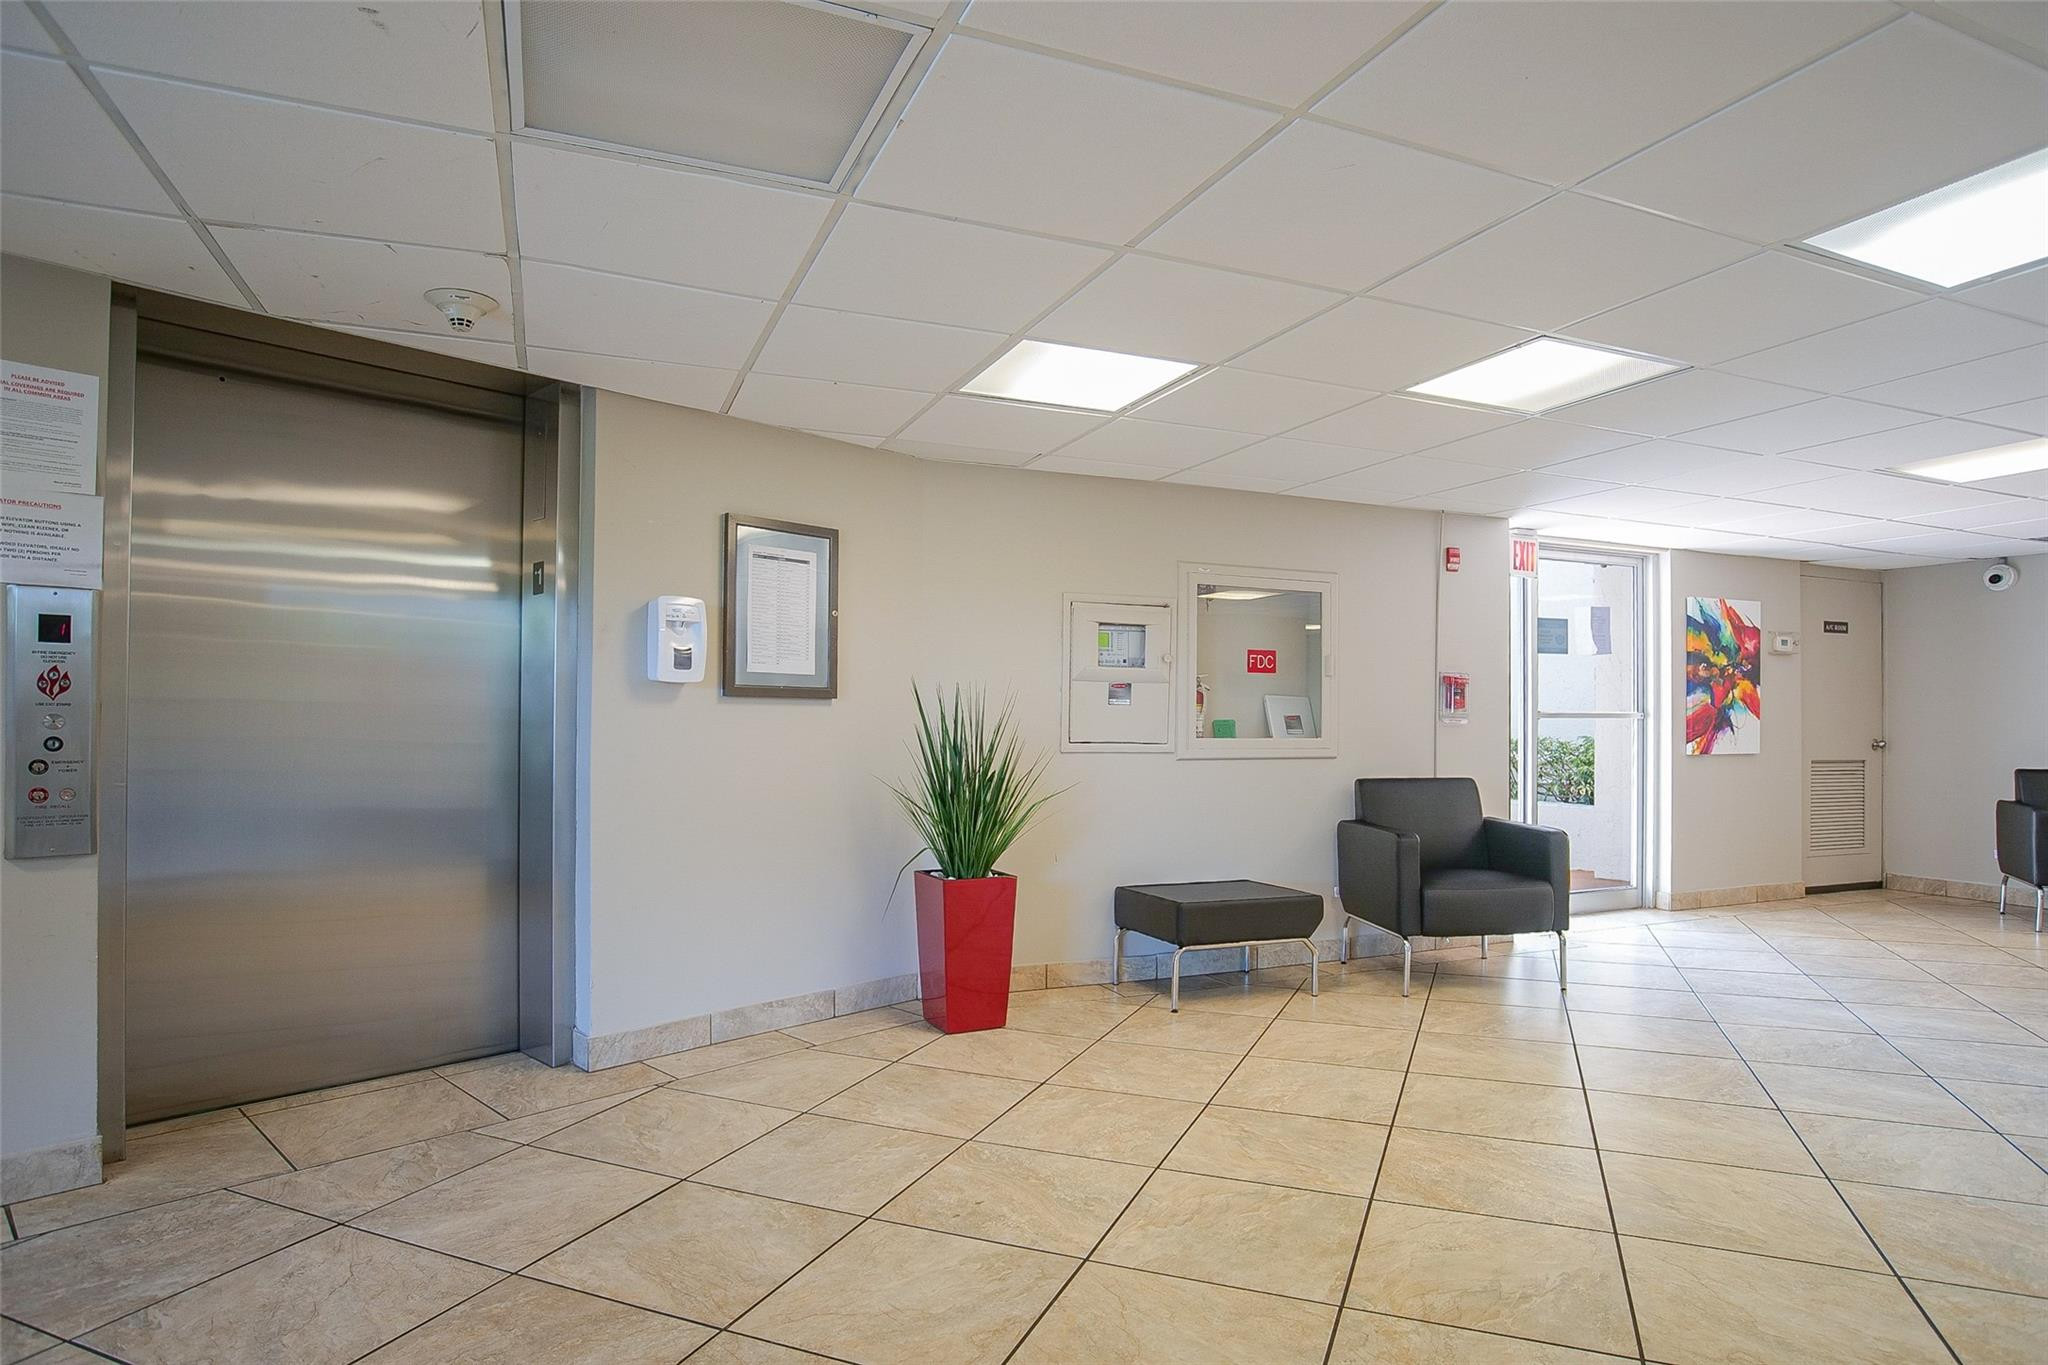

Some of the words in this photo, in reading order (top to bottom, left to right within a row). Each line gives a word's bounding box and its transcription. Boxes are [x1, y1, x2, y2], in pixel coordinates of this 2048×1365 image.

[18, 500, 62, 510] PRECAUTIONS
[1513, 540, 1536, 572] EXIT
[1249, 654, 1275, 669] FDC
